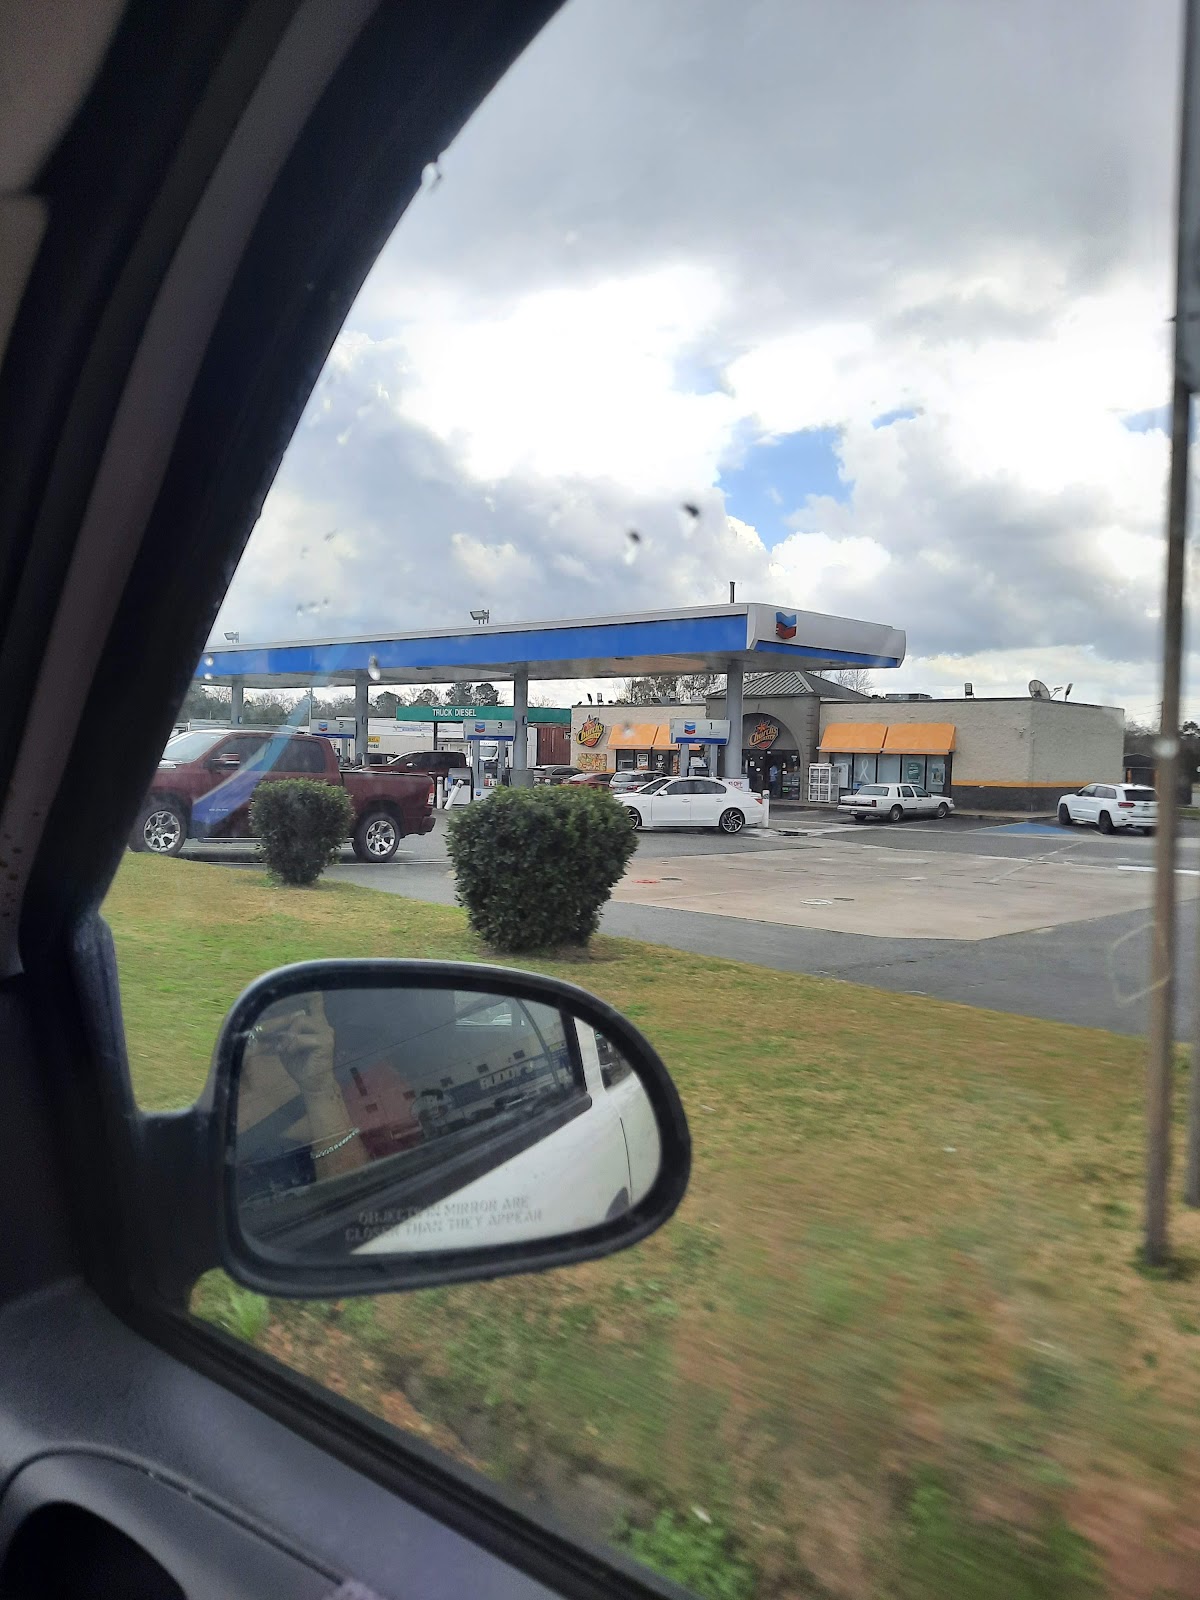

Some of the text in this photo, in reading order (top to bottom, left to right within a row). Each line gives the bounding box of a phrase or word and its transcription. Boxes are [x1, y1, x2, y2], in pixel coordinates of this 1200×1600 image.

[432, 708, 477, 717] TRUCK DIESEL
[339, 721, 344, 729] 5
[497, 721, 503, 729] 3
[709, 722, 713, 730] 1
[444, 1199, 498, 1215] MIRROR
[502, 1196, 530, 1210] ARE
[406, 1219, 444, 1236] THAN
[449, 1215, 483, 1231] THEY
[488, 1208, 543, 1226] APPEAR
